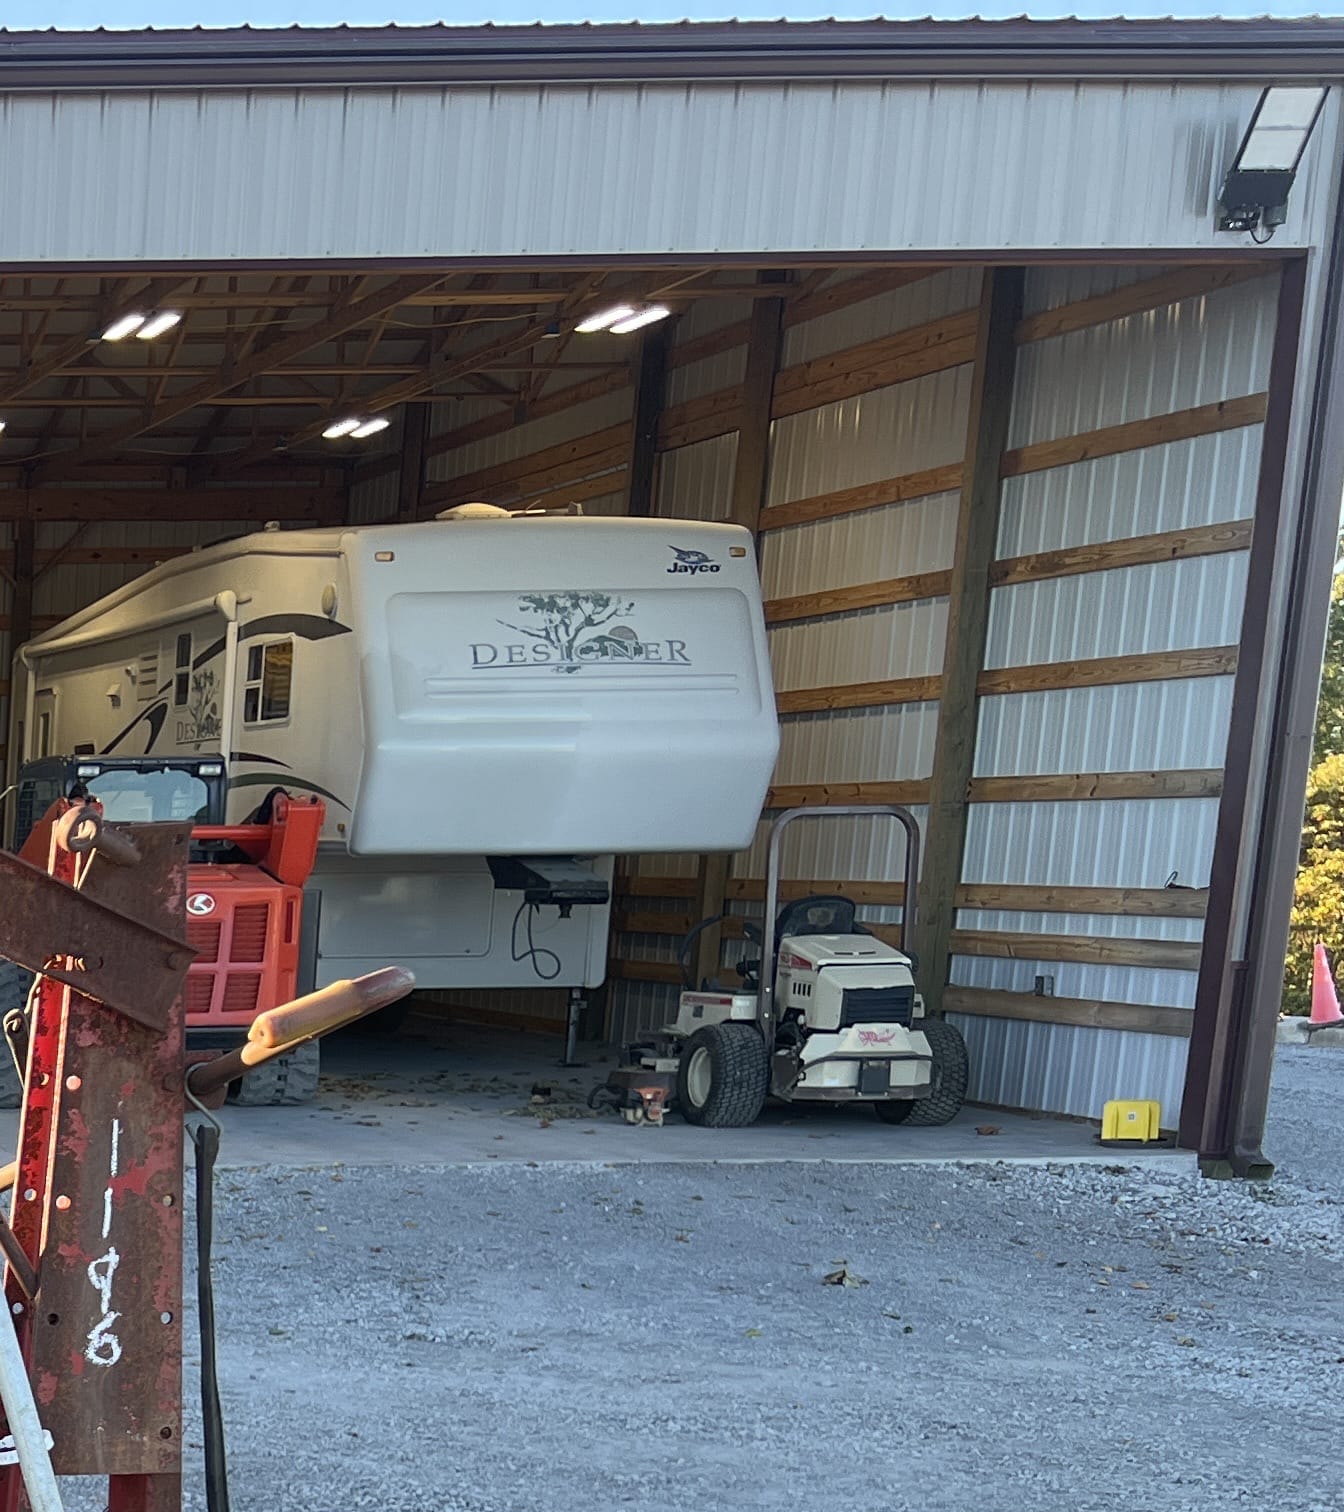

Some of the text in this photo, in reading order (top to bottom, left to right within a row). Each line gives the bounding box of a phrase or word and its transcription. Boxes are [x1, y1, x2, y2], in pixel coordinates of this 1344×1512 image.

[666, 562, 721, 576] Jayco
[468, 639, 693, 667] DESIGNER
[176, 718, 223, 742] DESIGNE
